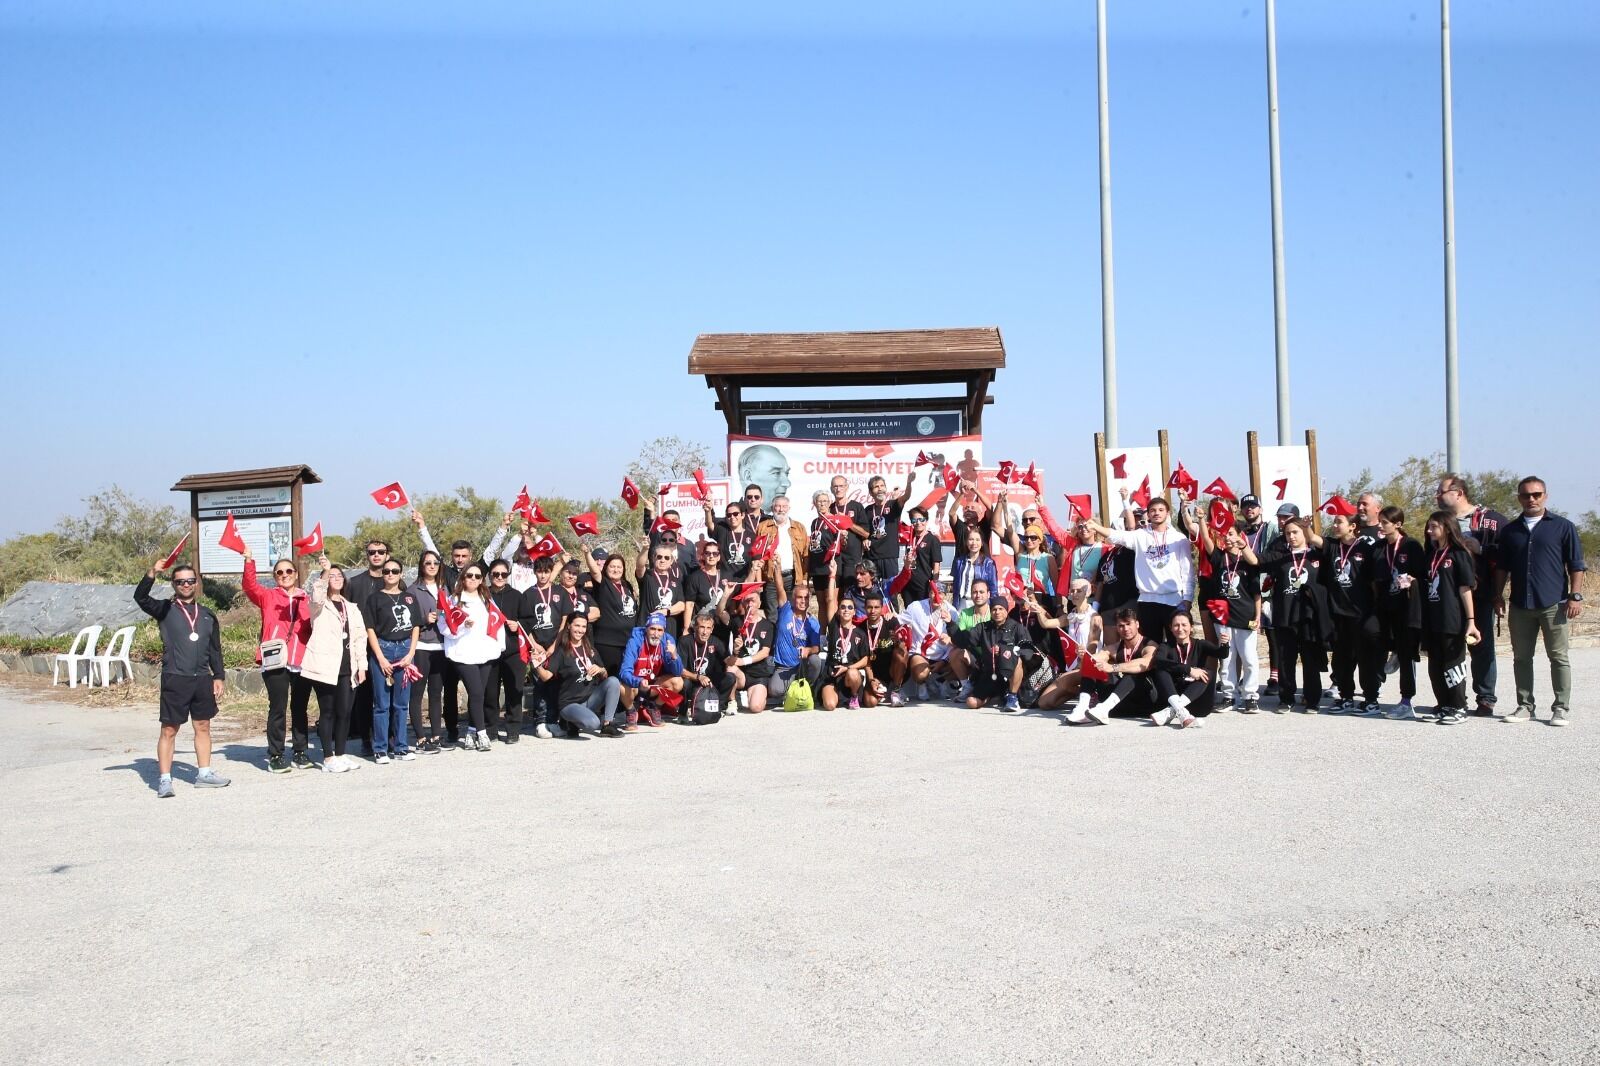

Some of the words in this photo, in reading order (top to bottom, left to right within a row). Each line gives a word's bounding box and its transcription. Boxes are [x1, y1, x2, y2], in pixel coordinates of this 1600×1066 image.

[827, 447, 839, 455] 29
[840, 447, 861, 455] EKİM
[803, 458, 915, 475] CUMHURİYET
[665, 498, 724, 508] CUMHURET
